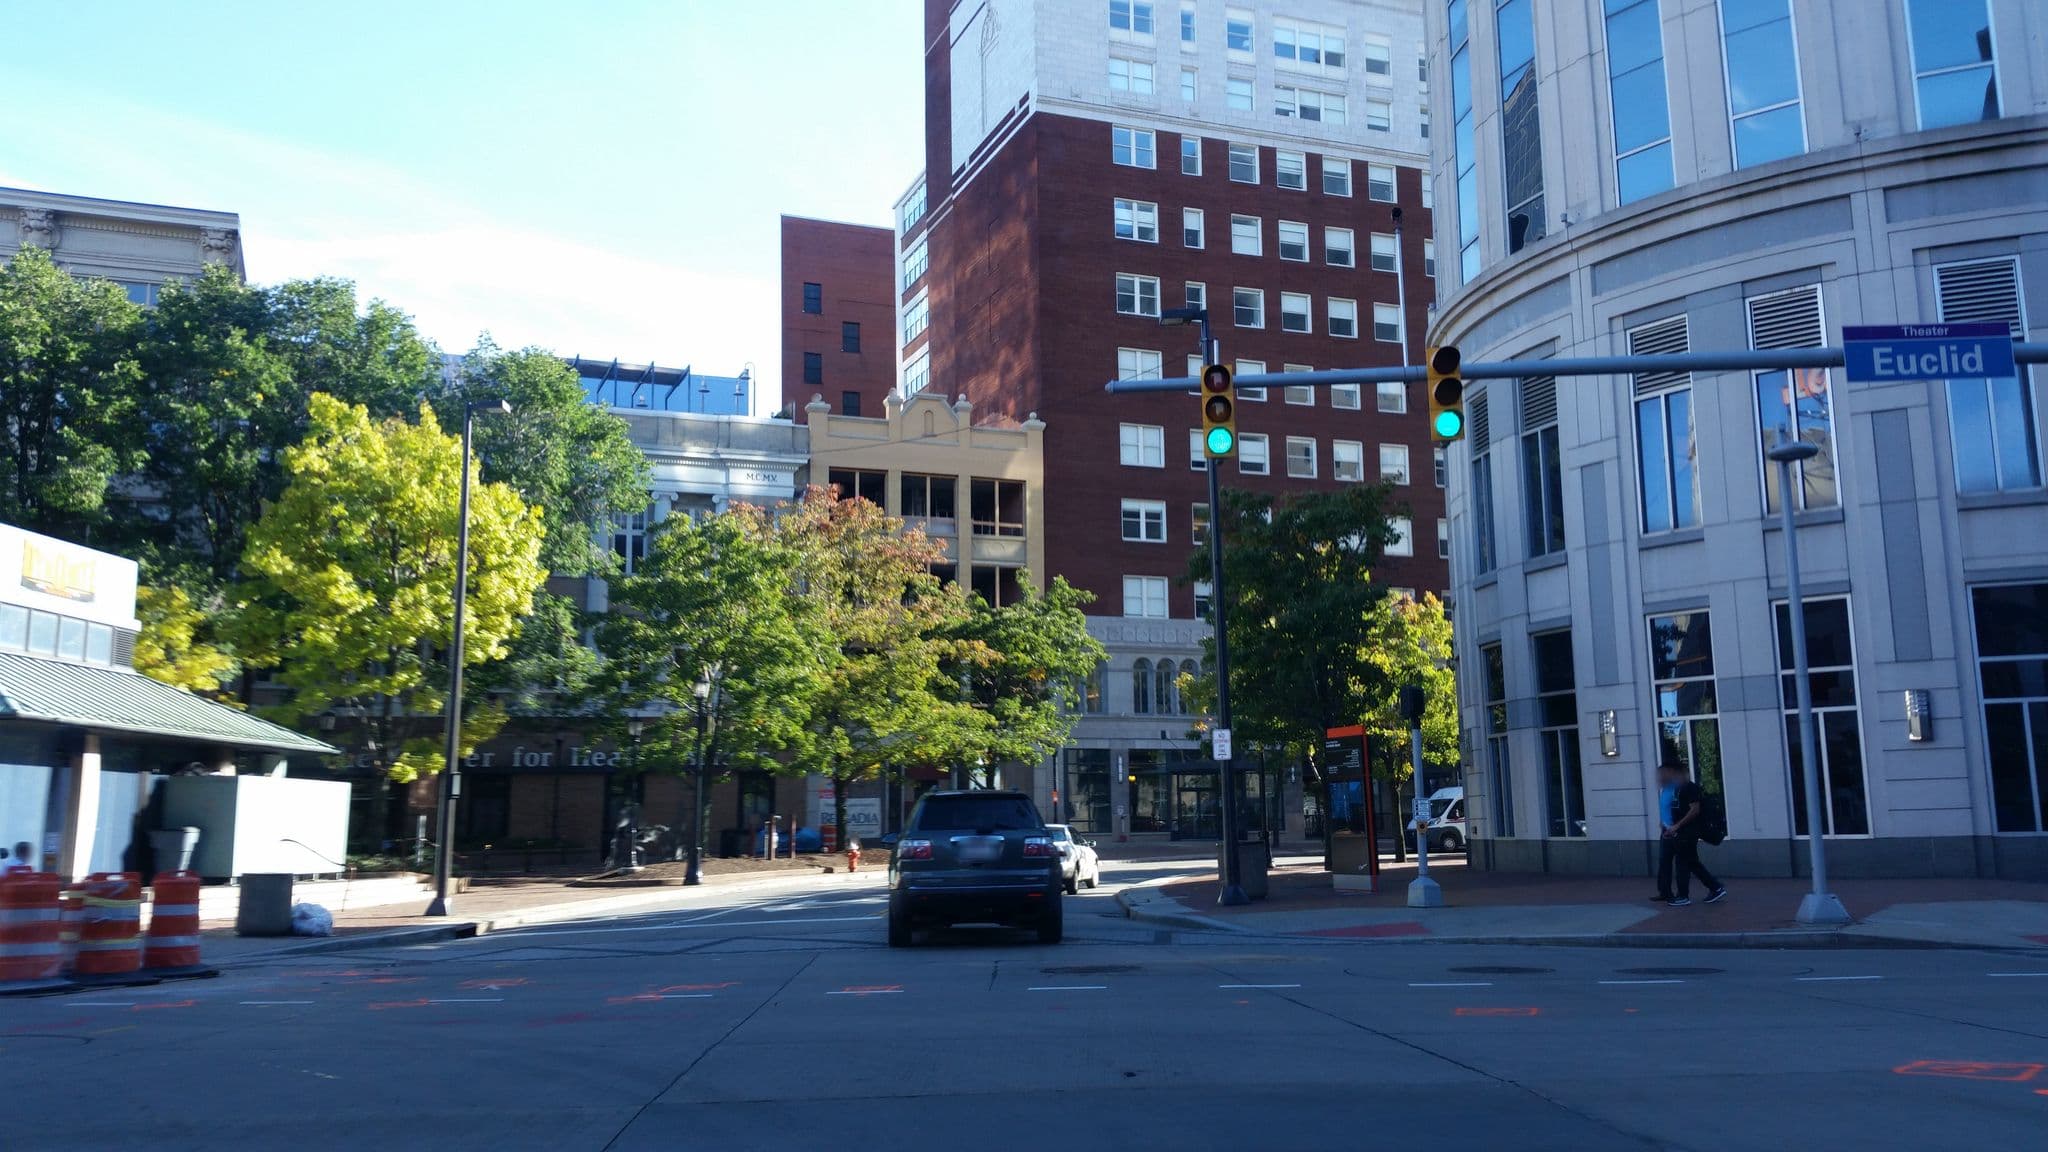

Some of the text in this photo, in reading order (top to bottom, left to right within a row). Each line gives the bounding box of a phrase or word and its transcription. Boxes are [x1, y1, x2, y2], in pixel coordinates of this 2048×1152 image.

[1902, 325, 1950, 337] Theater
[1872, 344, 1984, 375] Euclid
[512, 746, 553, 767] for
